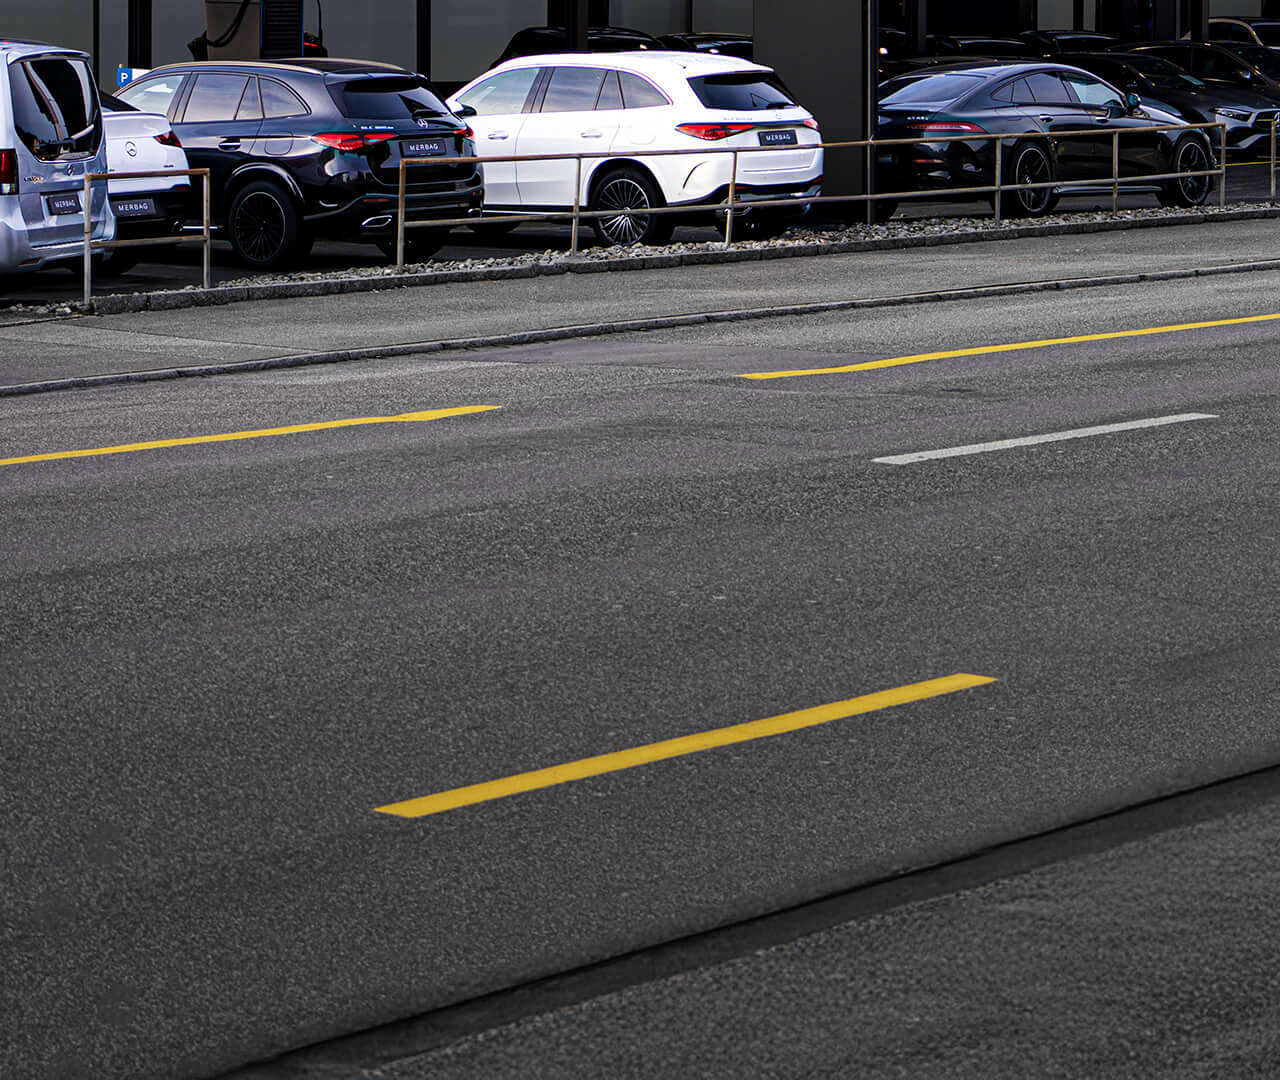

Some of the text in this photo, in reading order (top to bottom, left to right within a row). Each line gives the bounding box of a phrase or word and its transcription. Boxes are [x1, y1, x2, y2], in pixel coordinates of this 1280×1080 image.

[120, 72, 129, 83] P
[409, 143, 439, 152] MERBAG
[54, 199, 76, 209] MERBAG
[118, 202, 149, 212] MERBAG
